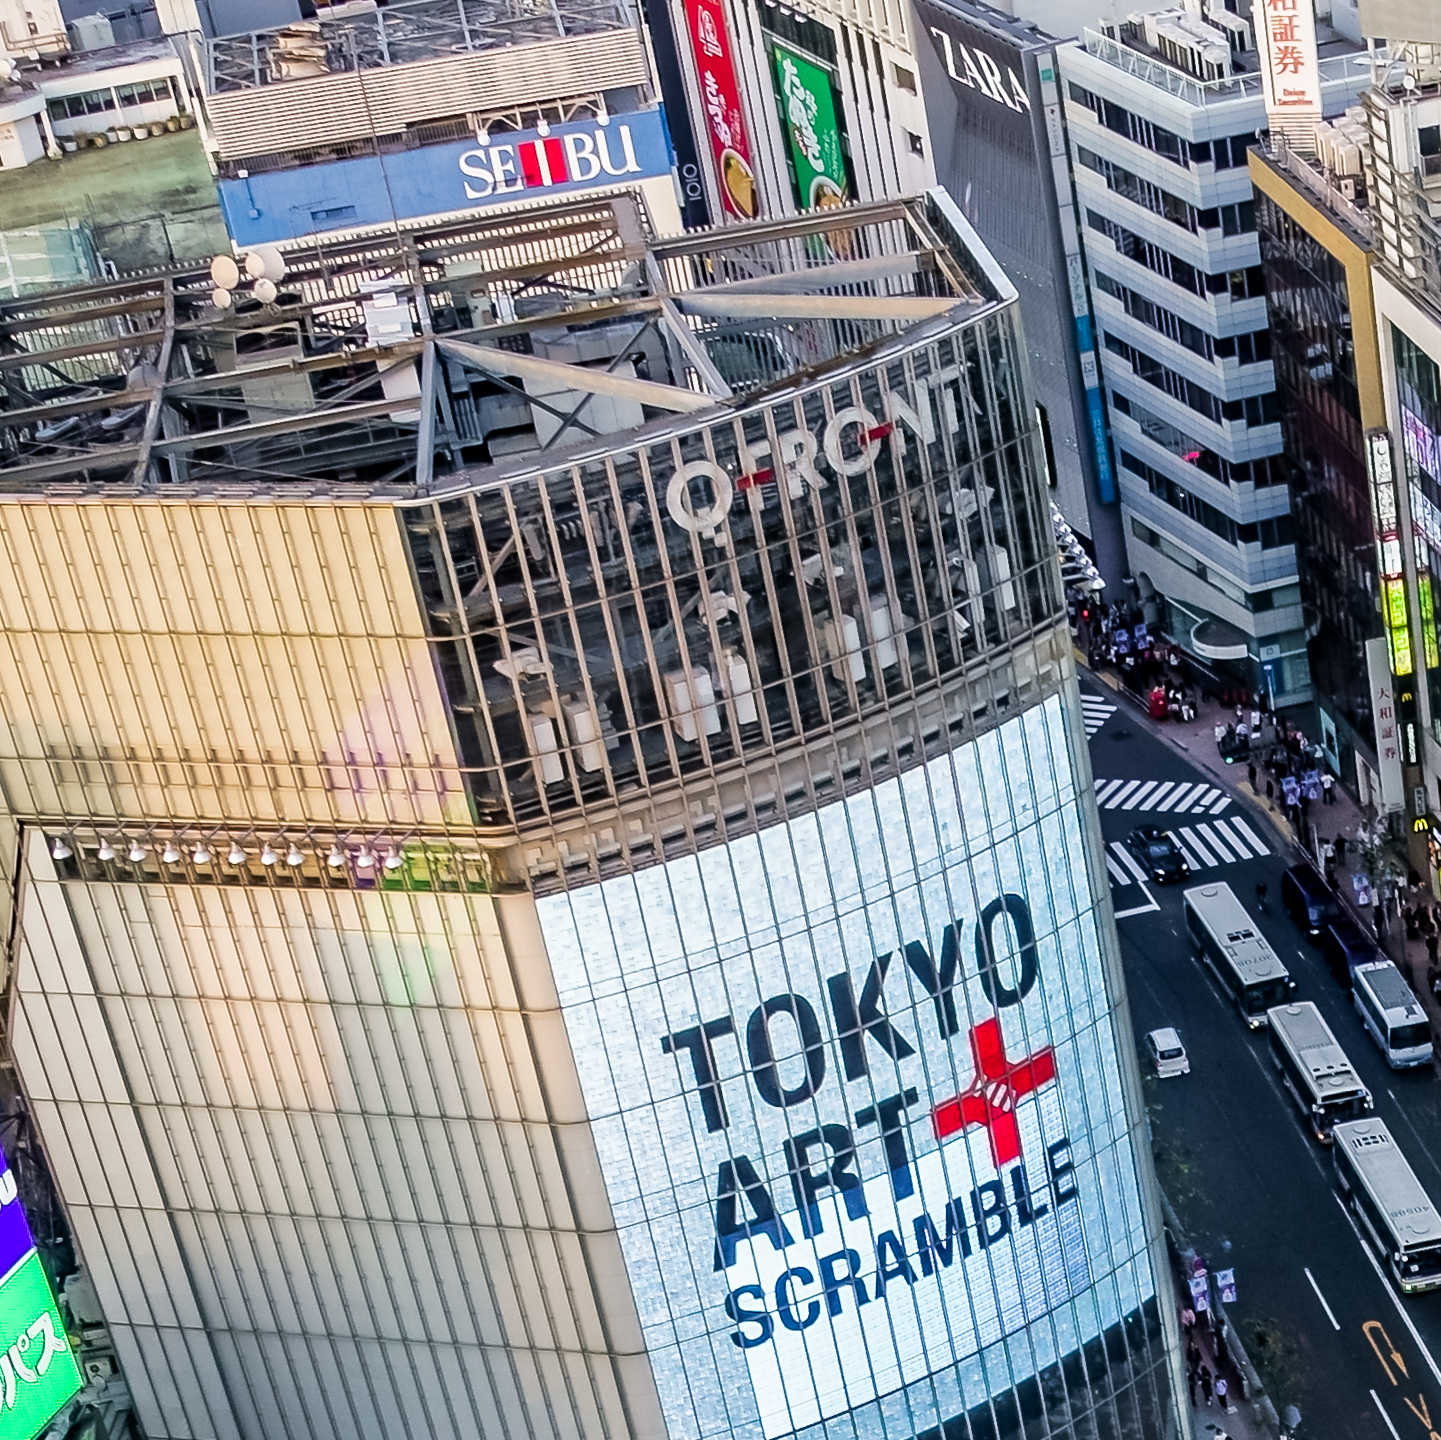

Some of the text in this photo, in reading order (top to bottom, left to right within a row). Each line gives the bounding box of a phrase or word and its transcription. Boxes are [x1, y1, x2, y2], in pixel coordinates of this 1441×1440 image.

[930, 25, 1031, 115] ZARA
[458, 124, 643, 200] SEIBU
[1378, 687, 1396, 760] 大和証券
[662, 893, 1036, 1135] TOKYO
[713, 1088, 918, 1271] ART
[723, 1138, 1077, 1348] SCRAMBLE
